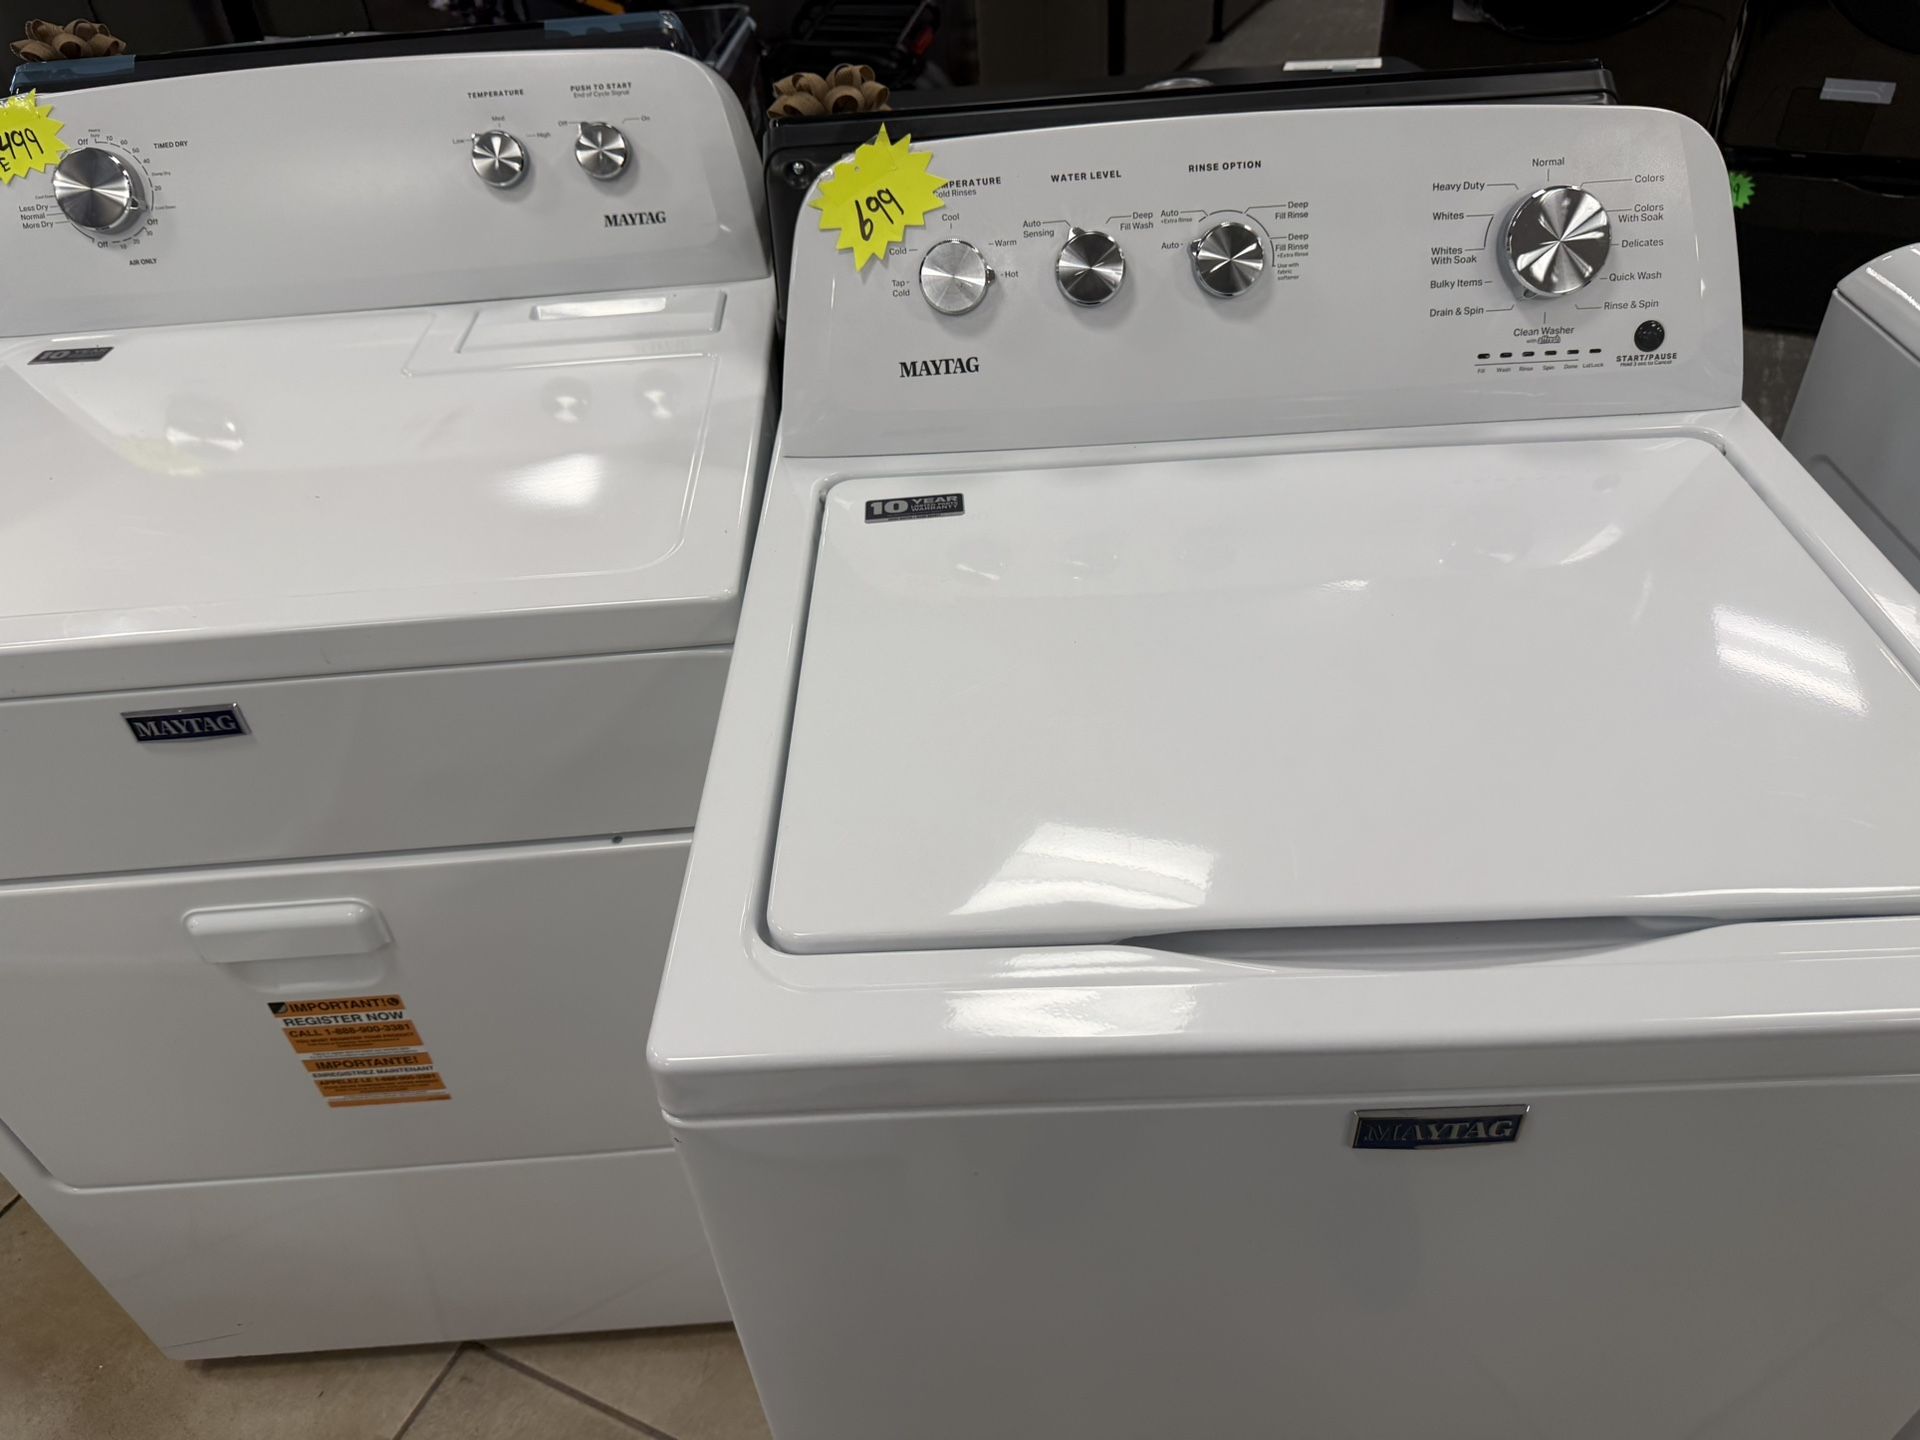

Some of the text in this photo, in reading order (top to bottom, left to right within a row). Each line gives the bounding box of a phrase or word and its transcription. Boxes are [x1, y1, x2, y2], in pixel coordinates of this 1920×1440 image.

[570, 82, 632, 92] PUSH TO START
[467, 89, 524, 99] TEMPERATURE
[593, 90, 611, 98] Cycle
[611, 89, 630, 97] Signal
[536, 131, 551, 139] High
[175, 140, 188, 148] DRY
[1188, 160, 1262, 173] RINSE OPTION
[1531, 157, 1565, 167] Normal
[1050, 170, 1122, 183] WATER LEVEL
[1634, 173, 1665, 183] Colors
[1432, 181, 1485, 193] Heavy Duty
[951, 188, 977, 197] Rinses
[19, 204, 49, 213] Less Dry
[1287, 200, 1309, 210] Deep
[1633, 203, 1664, 213] Colors
[21, 213, 46, 221] Normal
[855, 188, 904, 241] 699
[941, 213, 960, 221] Cool
[1132, 211, 1154, 221] Deep
[1160, 209, 1180, 217] Auto
[1275, 210, 1309, 220] Fill Rinse
[1432, 211, 1465, 220] Whites
[1618, 212, 1664, 223] With Soak
[604, 211, 667, 228] MAYTAG
[1022, 219, 1042, 228] Auto
[42, 221, 54, 229] Dry
[1120, 221, 1154, 231] Fill Wash
[1023, 229, 1055, 239] Sensing
[1287, 233, 1309, 242] Deep
[995, 239, 1017, 247] Warm
[1161, 241, 1180, 250] Auto
[1275, 242, 1309, 251] Fill Rinse
[1621, 238, 1664, 248] Delicates
[889, 247, 907, 256] Cold
[1431, 246, 1463, 255] Whites
[1431, 255, 1477, 265] With Soak
[1004, 270, 1019, 279] Hot
[1608, 271, 1662, 282] Quick Wash
[892, 279, 906, 289] Tap
[1430, 278, 1483, 290] Bulky Items
[892, 289, 910, 298] Cold
[1603, 300, 1659, 310] Rinse & Spin
[1429, 306, 1484, 318] Drain & Spin
[1513, 326, 1575, 337] Clean Washer
[1616, 352, 1678, 362] START/PAUSE
[899, 356, 980, 378] MAYTAG
[911, 495, 958, 504] YEAR
[870, 500, 909, 515] 10
[133, 715, 237, 737] MAYTAG
[289, 997, 387, 1013] IMPORTANT!
[283, 1011, 403, 1027] REGISTER NOW
[289, 1028, 322, 1038] CALL
[315, 1055, 418, 1071] IMPORTANTE!
[1364, 1120, 1513, 1141] MAYTAG
